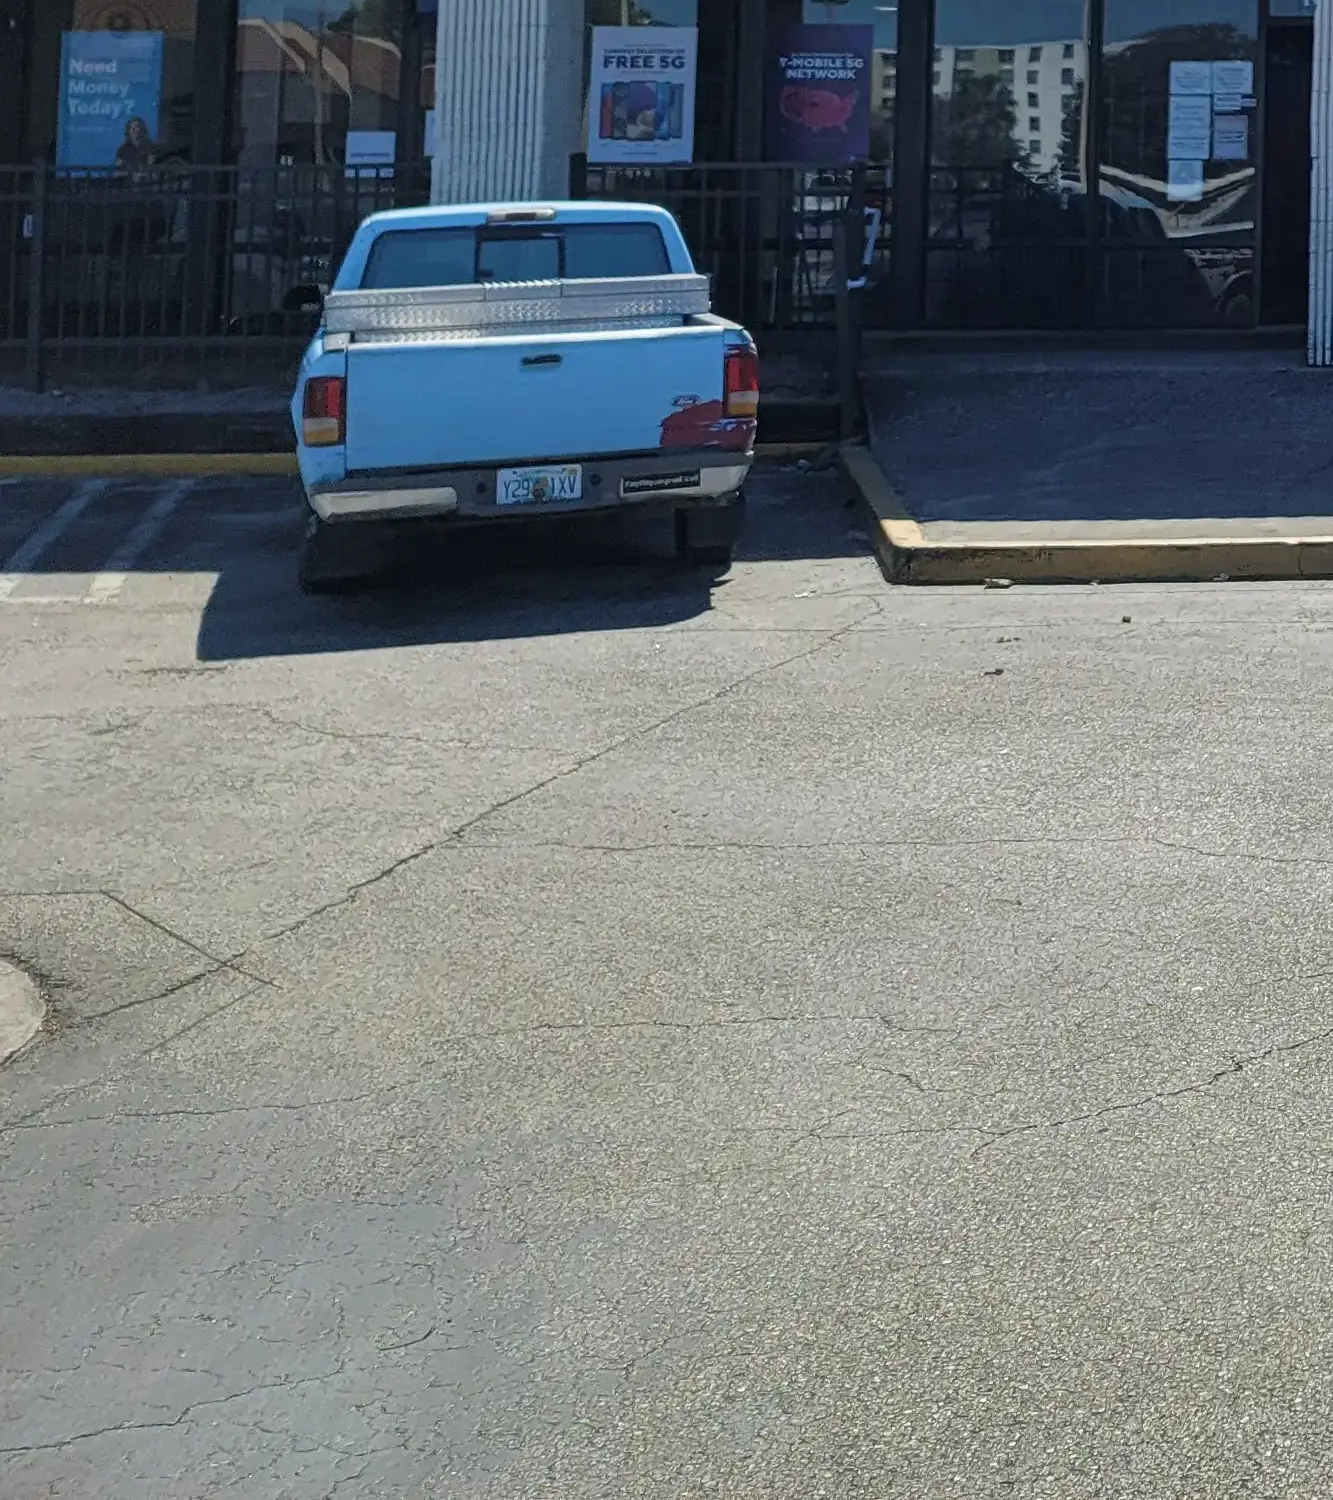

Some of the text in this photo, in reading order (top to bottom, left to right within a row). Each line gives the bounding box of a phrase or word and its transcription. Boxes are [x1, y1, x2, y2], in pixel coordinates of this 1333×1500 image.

[69, 58, 117, 74] Need
[603, 55, 686, 69] FREE 5G
[779, 57, 865, 68] T-MOBILE 5G
[786, 69, 857, 79] NETWORK
[68, 79, 131, 98] Money
[67, 97, 136, 120] Today?
